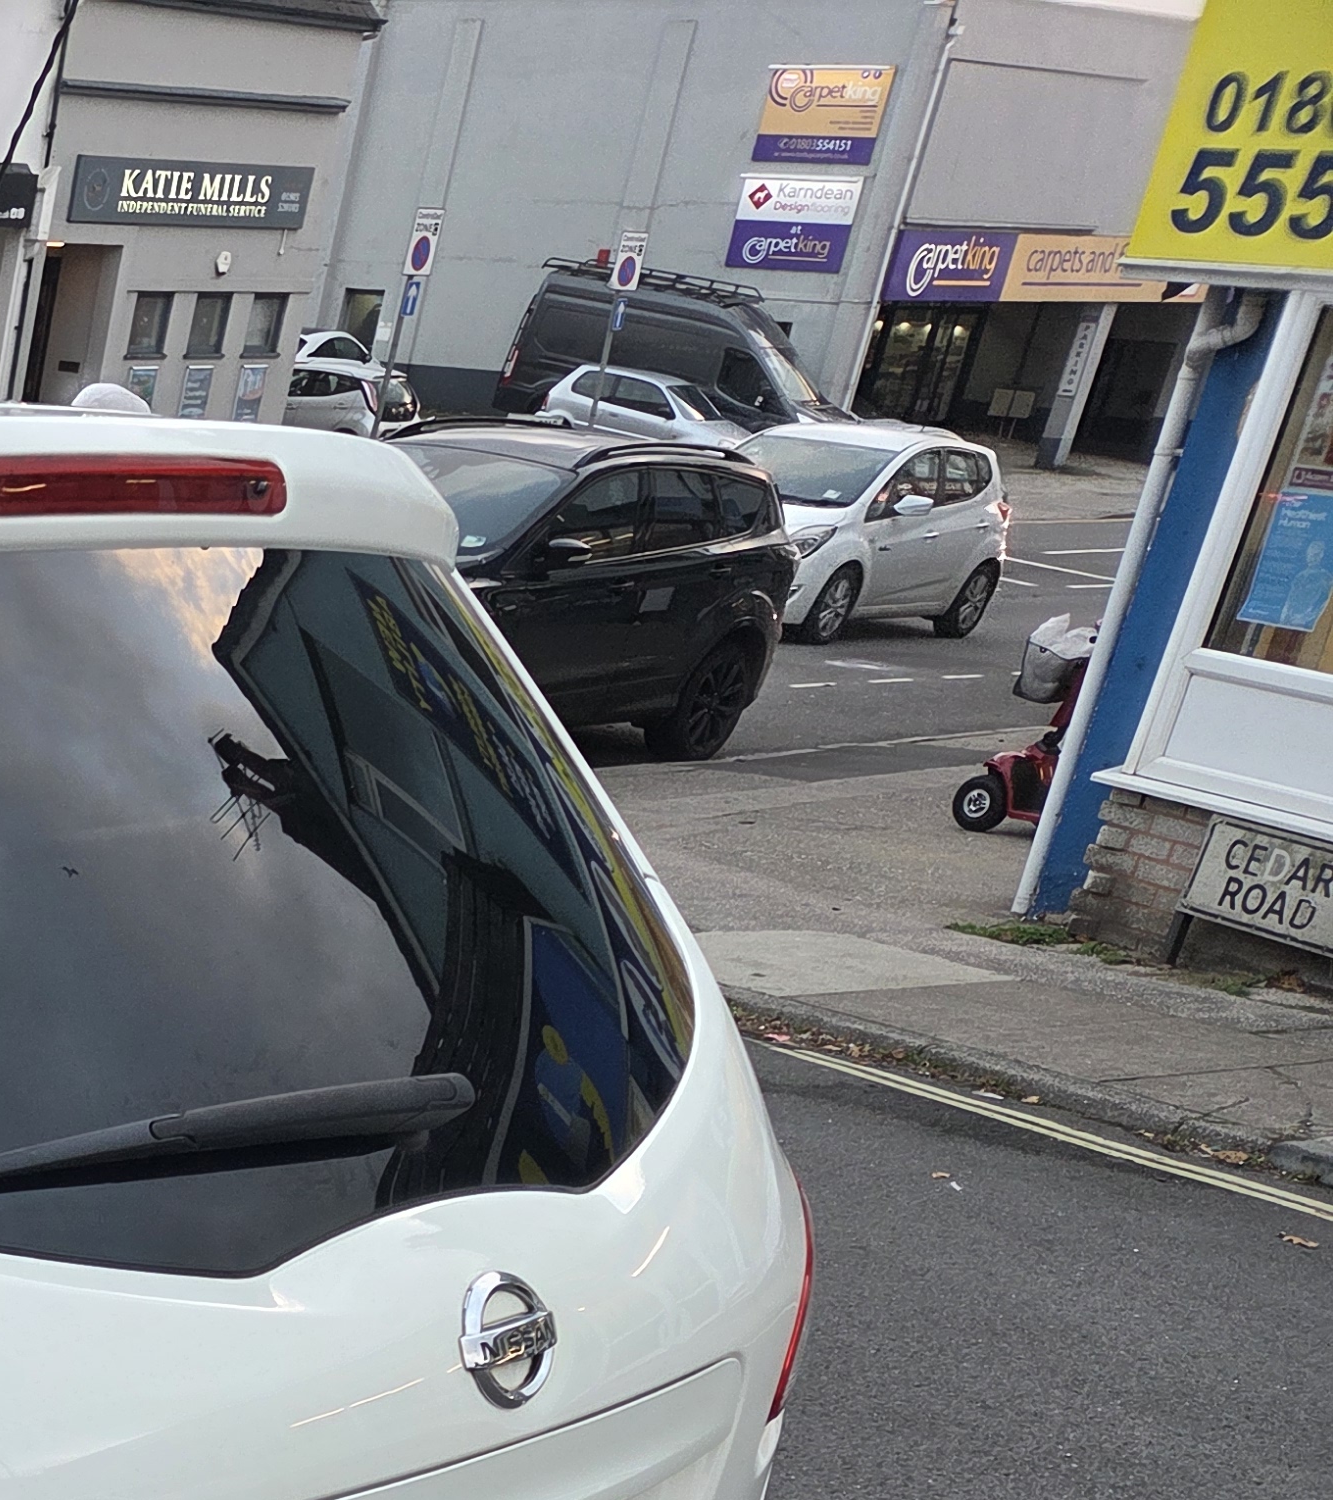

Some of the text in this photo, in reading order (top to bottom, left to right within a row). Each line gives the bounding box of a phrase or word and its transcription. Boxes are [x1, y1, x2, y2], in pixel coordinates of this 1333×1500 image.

[1206, 71, 1333, 134] 018
[120, 168, 273, 203] KATIE MILLS
[777, 183, 854, 201] Karndean
[117, 200, 188, 215] INDEPENDENT
[187, 203, 227, 217] FUNERAL
[228, 205, 267, 218] SERVICE
[790, 225, 802, 234] at
[1027, 246, 1085, 280] carpets
[1085, 243, 1118, 274] and
[1224, 838, 1333, 899] CEDAR
[1217, 875, 1317, 931] ROAD
[479, 1314, 554, 1363] NISSAN
